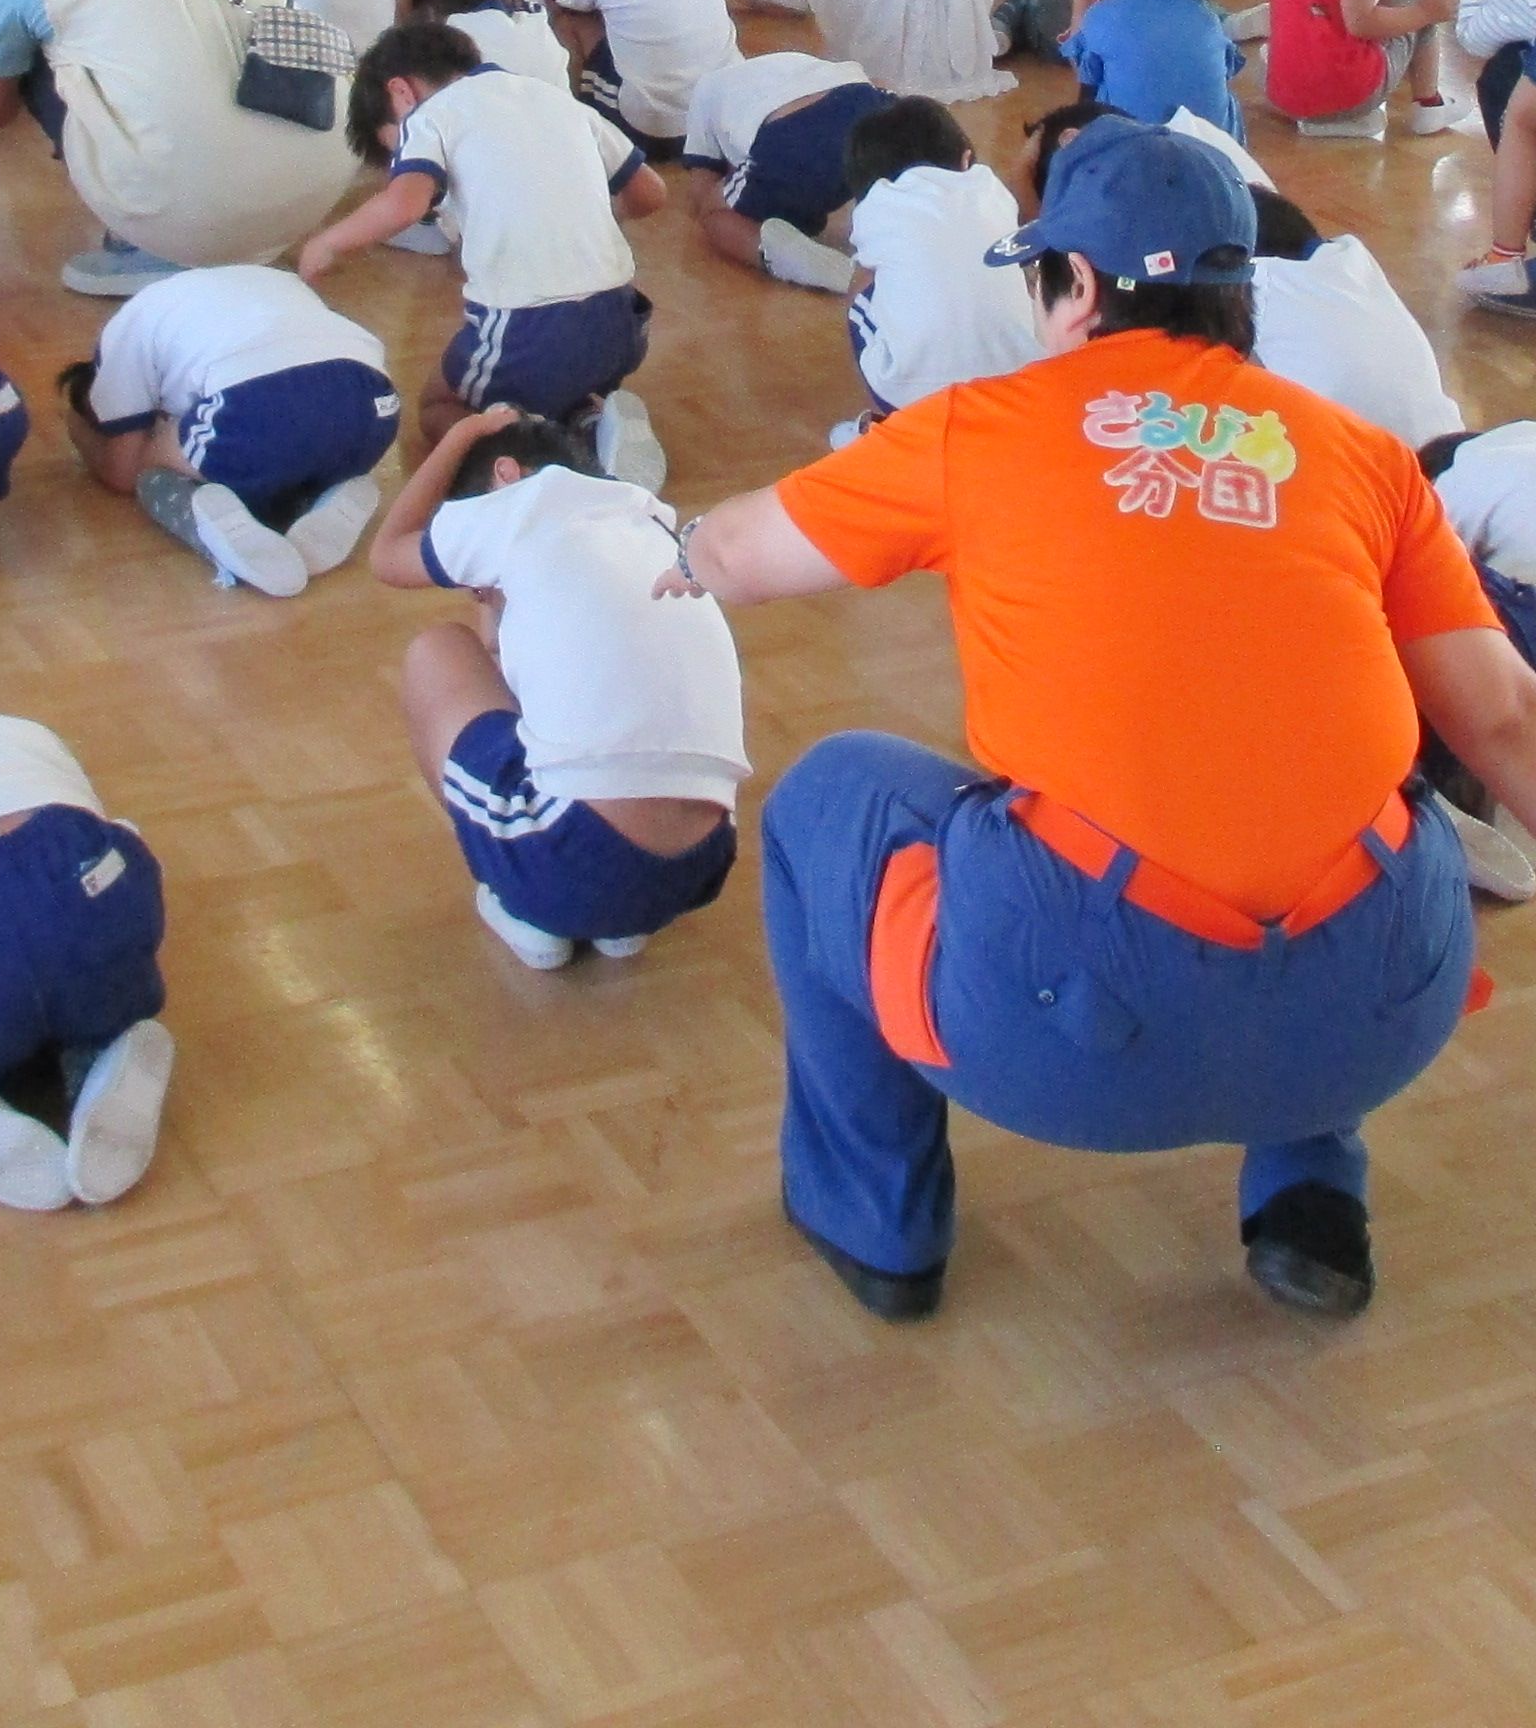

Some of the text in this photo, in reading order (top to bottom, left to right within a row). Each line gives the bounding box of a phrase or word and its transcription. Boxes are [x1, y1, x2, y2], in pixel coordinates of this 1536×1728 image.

[1083, 390, 1297, 484] さるびあ
[1103, 447, 1277, 529] 分団
